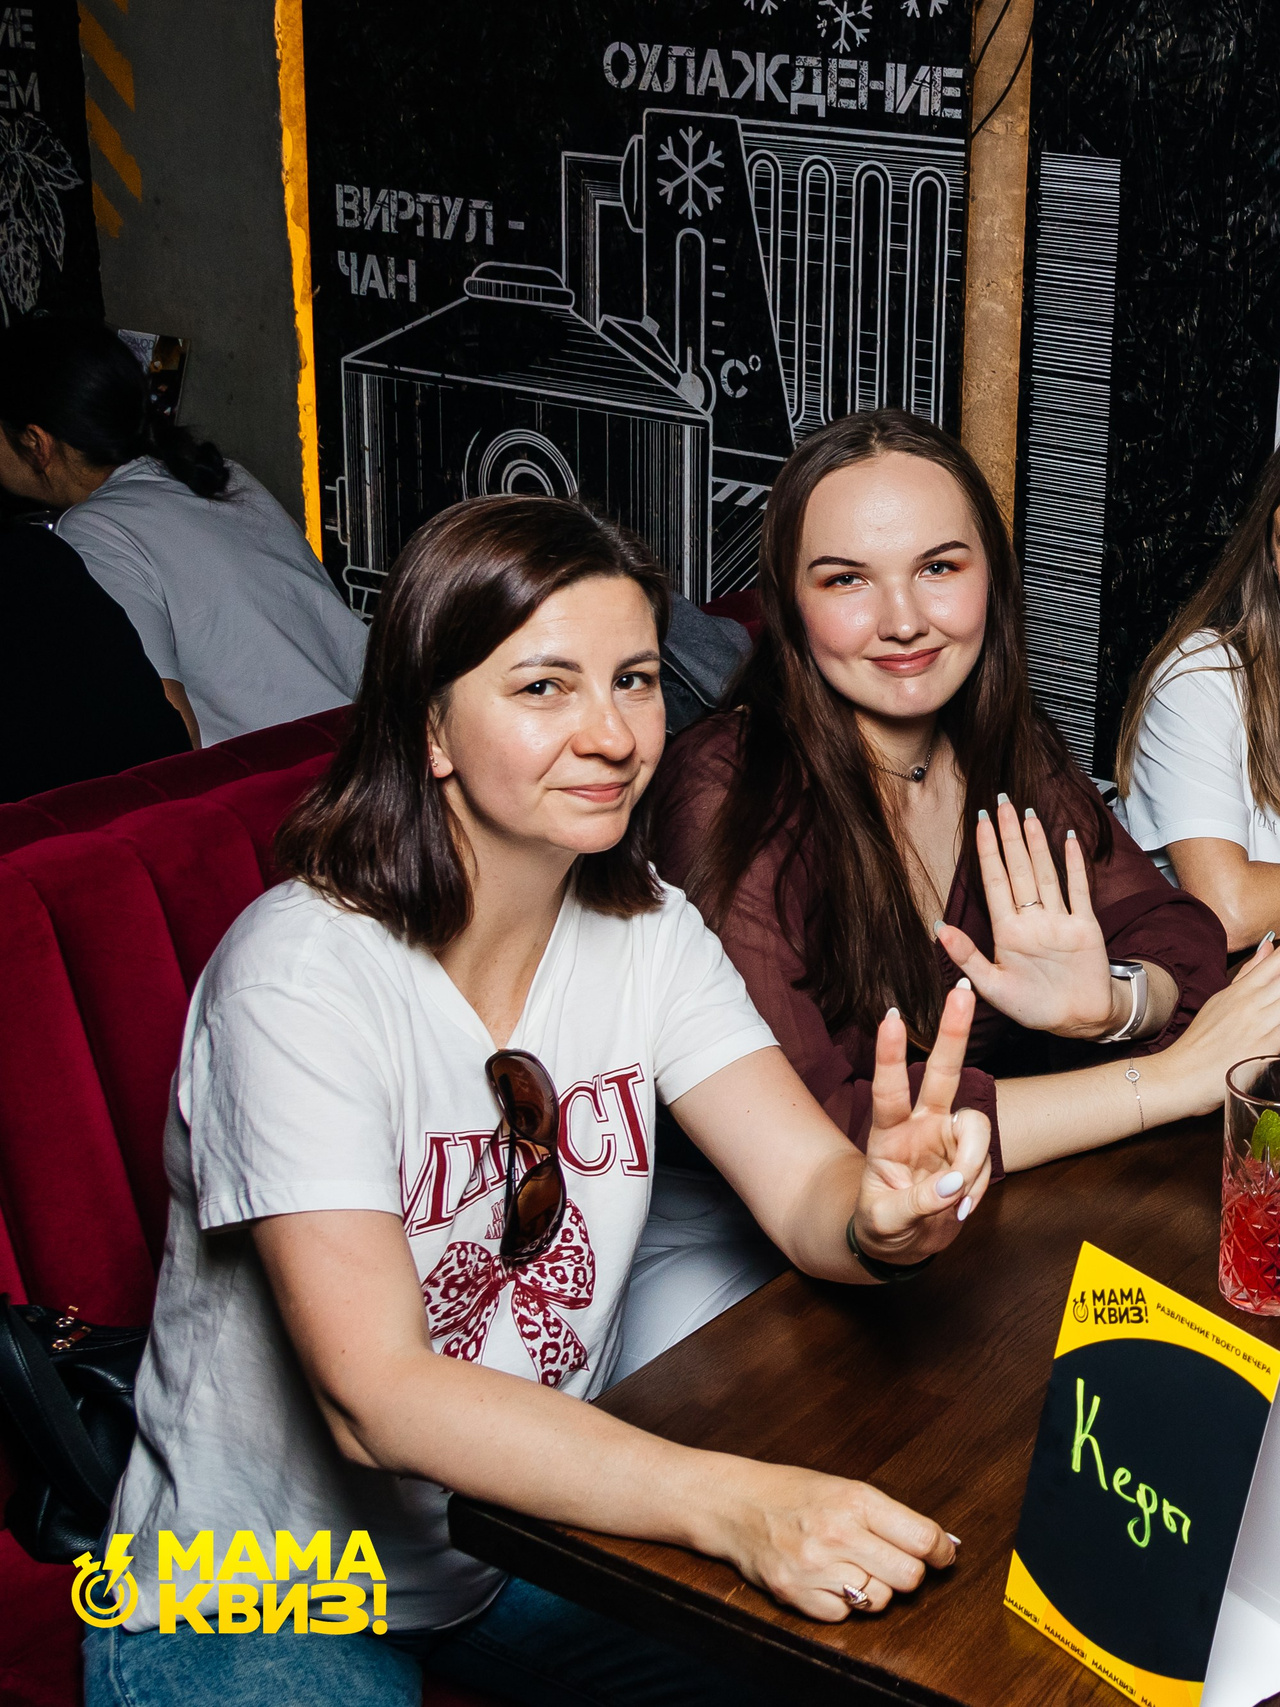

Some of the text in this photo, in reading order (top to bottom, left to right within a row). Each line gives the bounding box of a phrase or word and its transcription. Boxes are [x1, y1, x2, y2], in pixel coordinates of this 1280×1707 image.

[602, 41, 965, 119] ОХЛАЖДЕНИЕ
[334, 183, 495, 246] ВИРПУЛ
[338, 250, 417, 303] ЧАН
[1092, 1287, 1147, 1306] МАМА
[1093, 1306, 1149, 1325] КВИЗ!
[1156, 1302, 1272, 1375] РАЗВЛЕЧЕНИЕ ТВОЕГО ВЕЧЕРА
[1044, 1624, 1088, 1660] МАМАКВИЗ!
[1091, 1658, 1137, 1697] МАМАКВИЗ!
